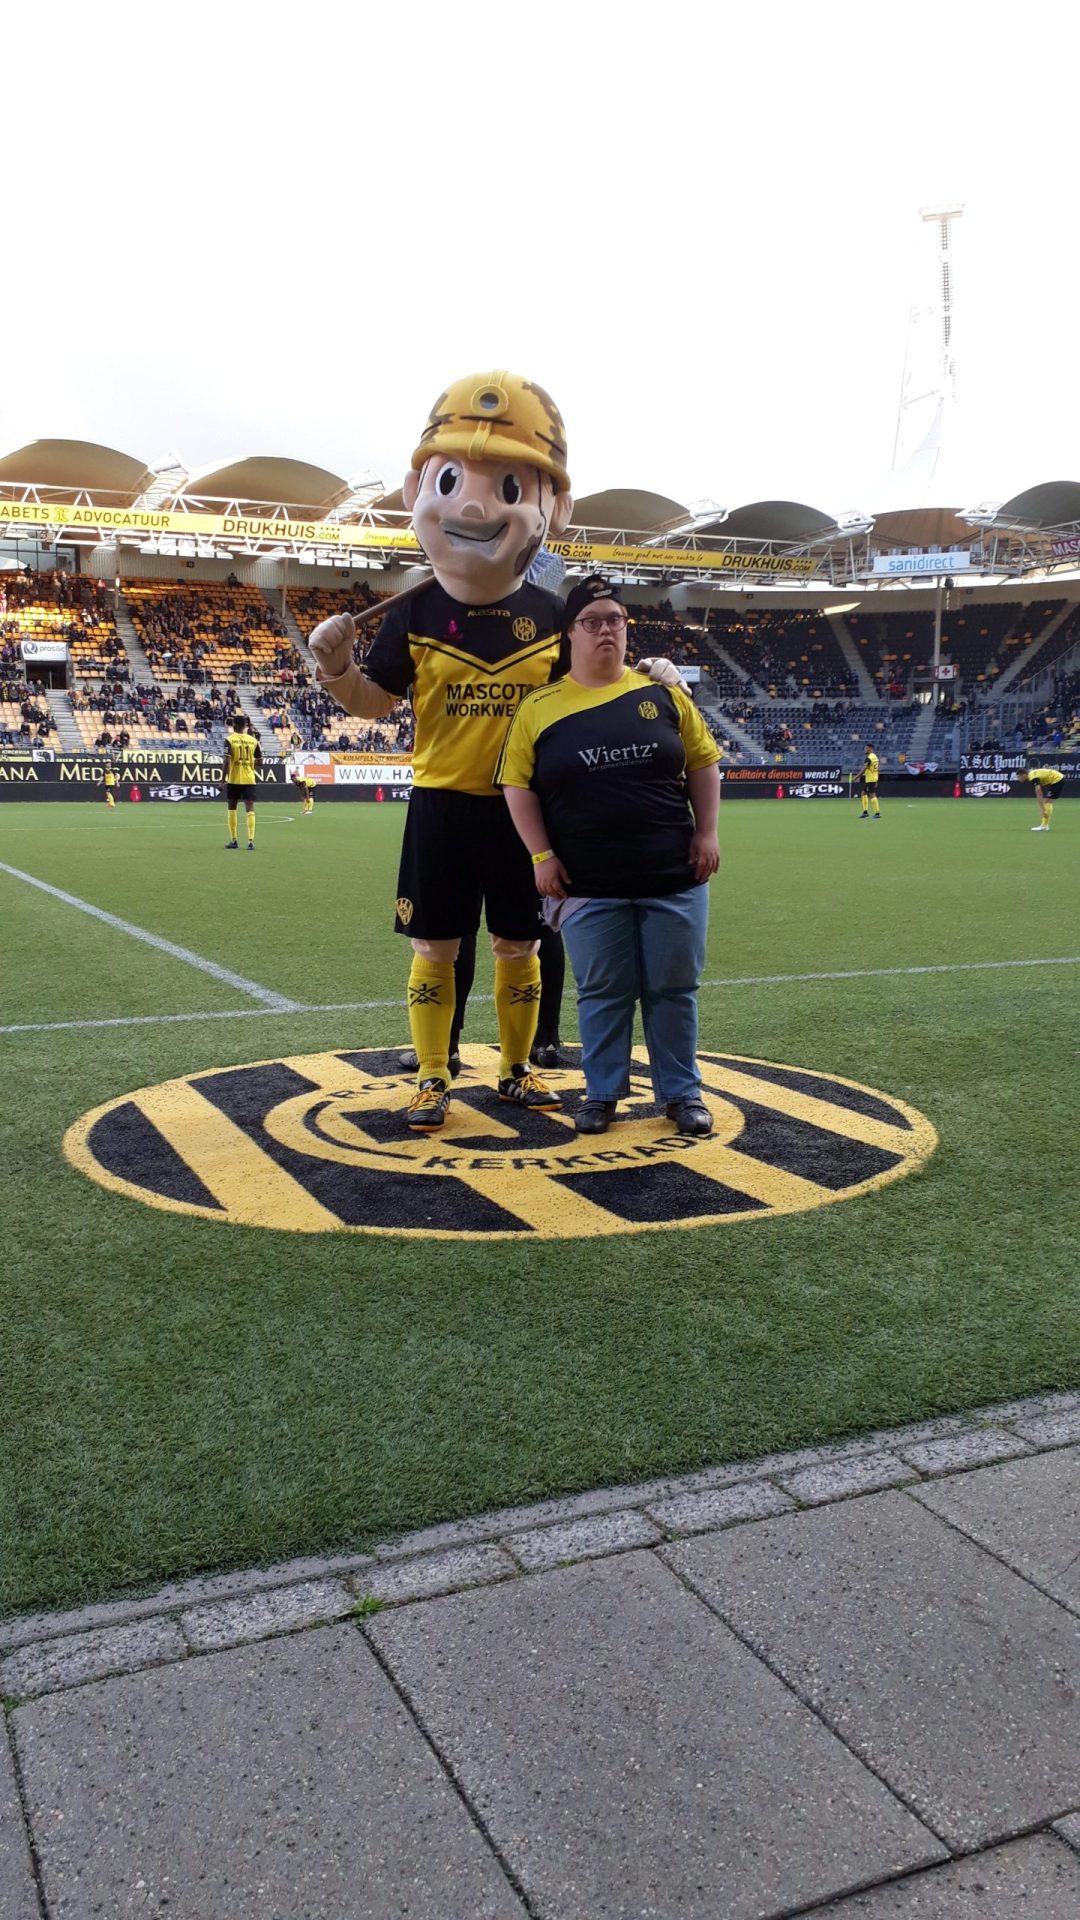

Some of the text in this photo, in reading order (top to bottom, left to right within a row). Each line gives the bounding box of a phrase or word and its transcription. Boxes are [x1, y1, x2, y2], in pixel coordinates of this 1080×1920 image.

[0, 506, 171, 527] ABETS ADVOCATUUR
[1052, 540, 1080, 556] MAS
[888, 556, 955, 571] sanidirect
[127, 753, 199, 763] KOEMPELS
[726, 769, 767, 779] facilitaire
[768, 769, 803, 779] diensten
[804, 770, 829, 779] wenst
[829, 769, 840, 779] u?
